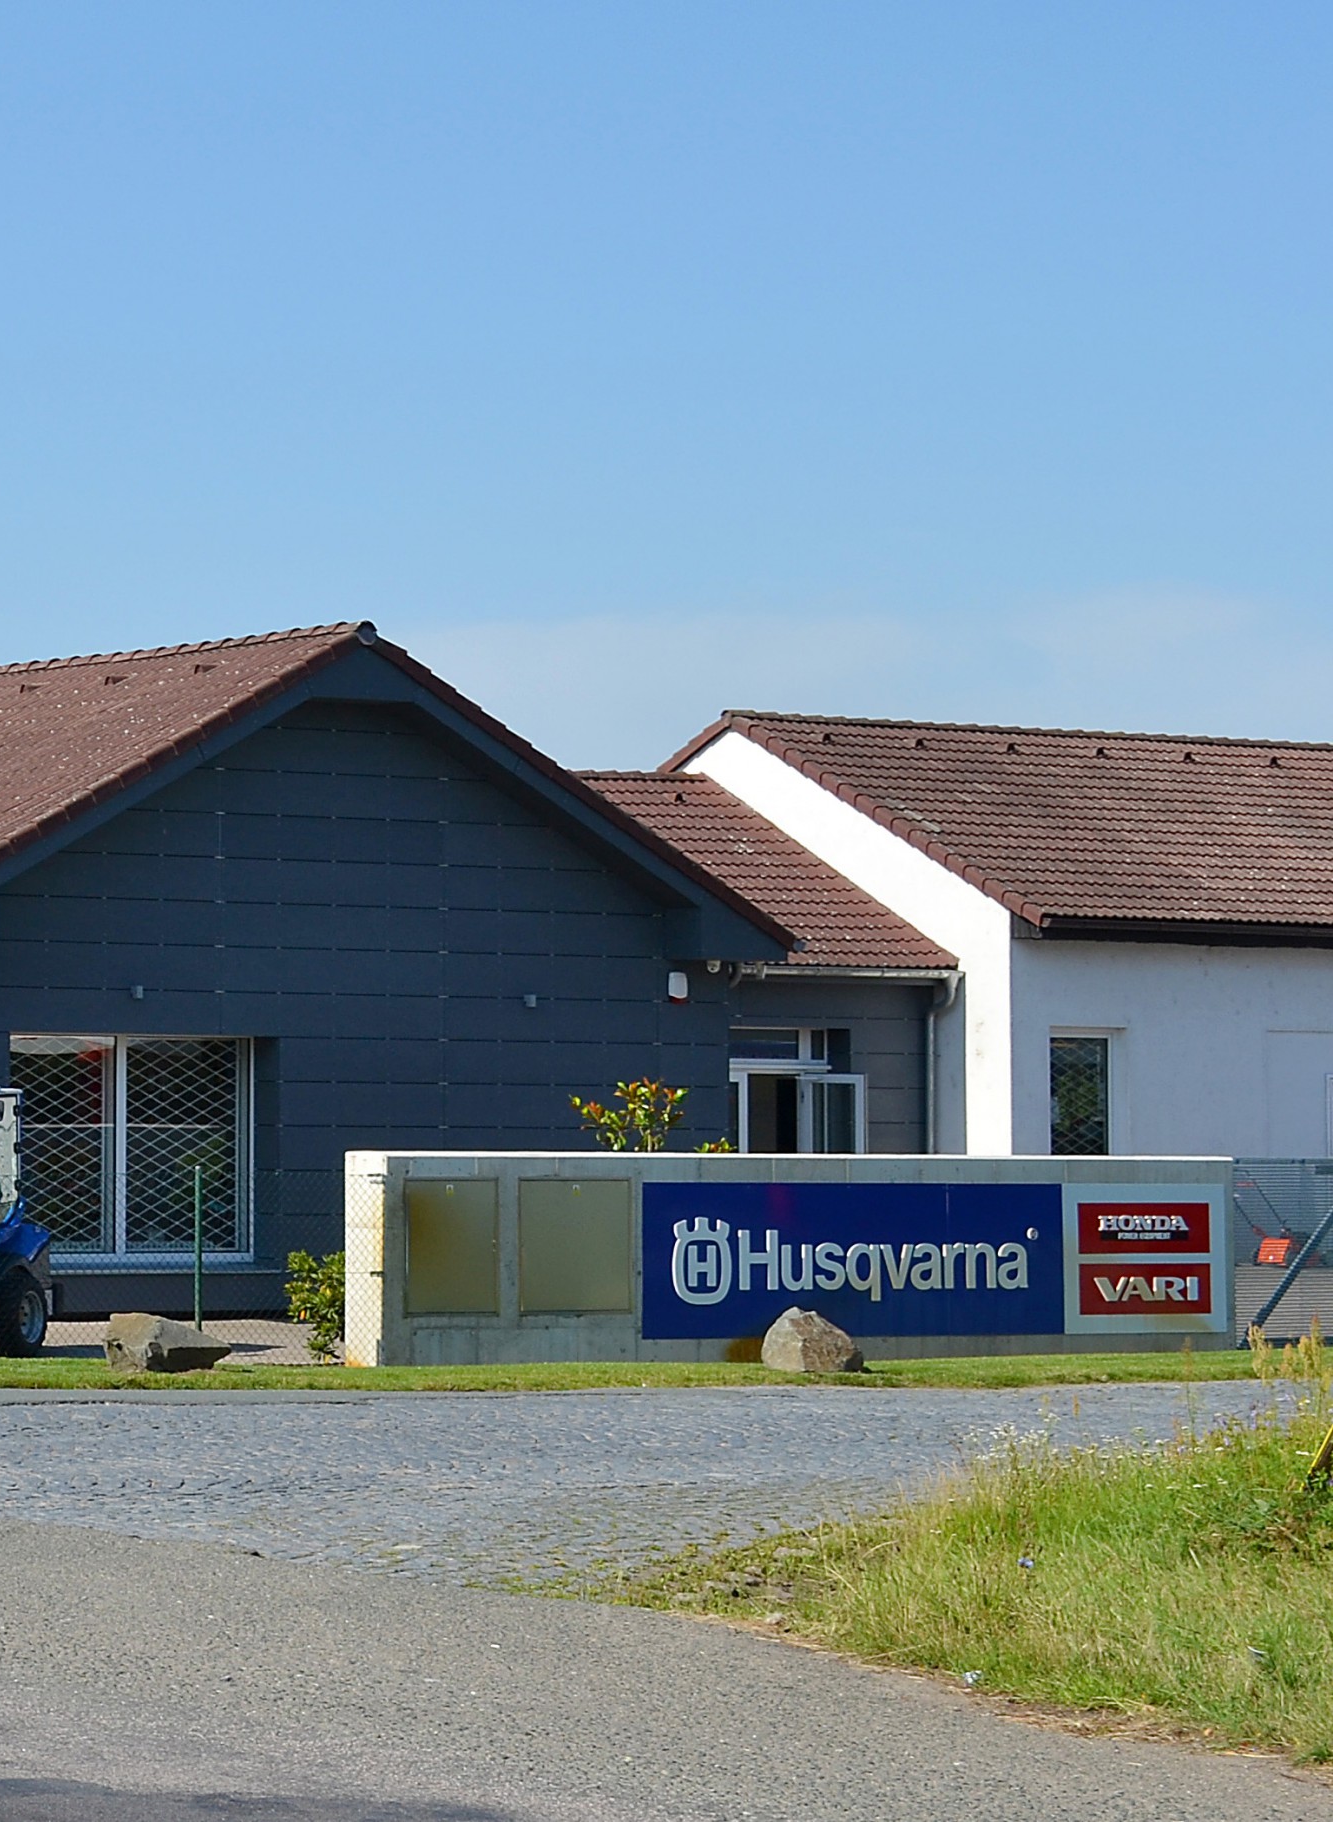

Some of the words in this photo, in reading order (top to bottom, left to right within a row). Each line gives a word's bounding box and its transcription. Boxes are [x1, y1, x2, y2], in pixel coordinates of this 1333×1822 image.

[1097, 1214, 1190, 1232] HONDA
[738, 1228, 1029, 1302] Husqvarna
[1093, 1276, 1200, 1302] VARI
